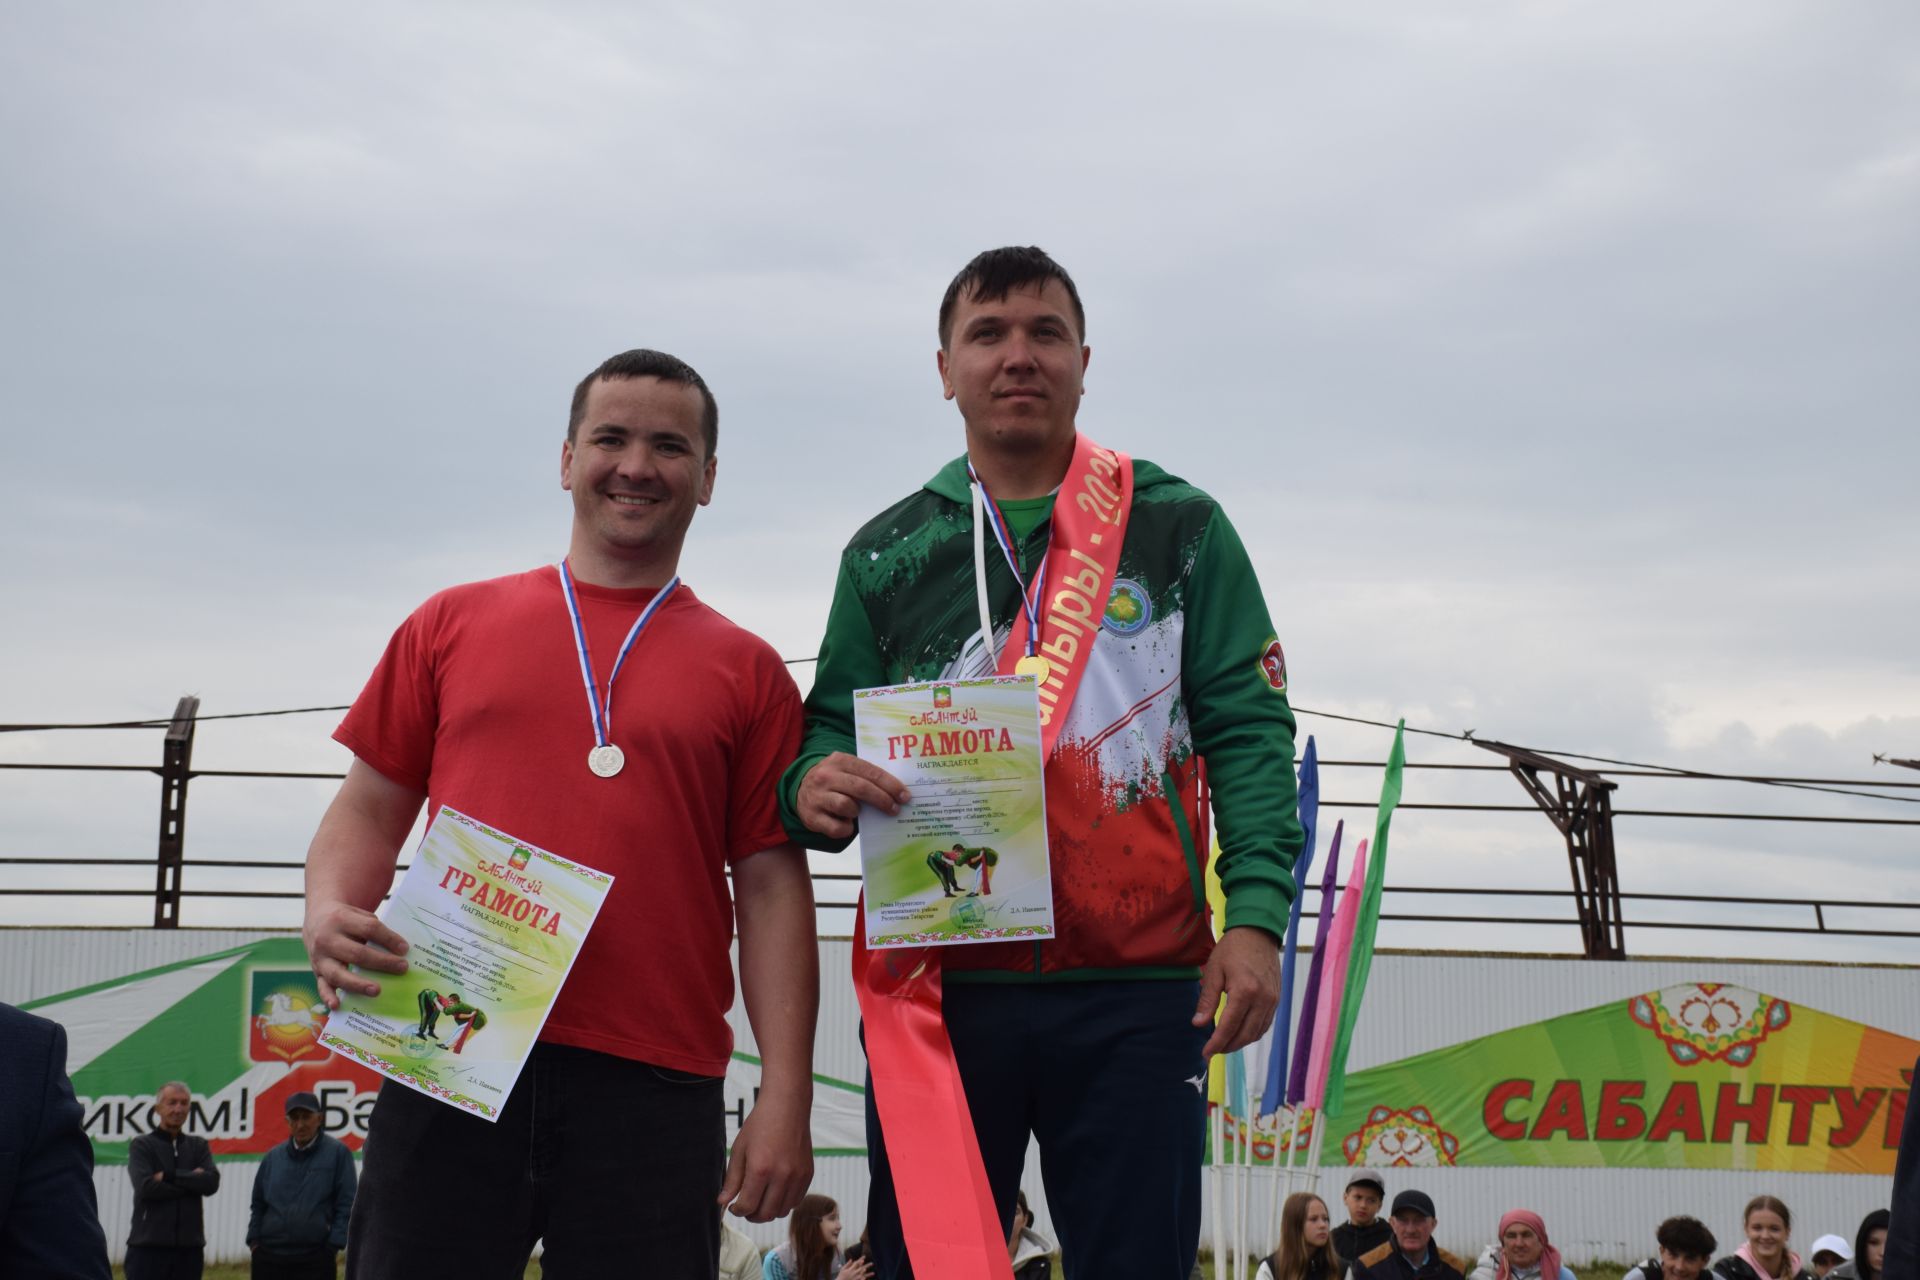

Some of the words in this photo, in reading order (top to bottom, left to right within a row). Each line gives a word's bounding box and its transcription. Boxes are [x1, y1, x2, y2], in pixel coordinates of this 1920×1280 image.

[888, 727, 1015, 760] ГРАМОТА
[917, 758, 978, 769] НАГРАЖДАЕТСЯ
[439, 866, 561, 936] ГРАМОТА
[461, 904, 520, 934] НАГРАЖДАЕТСЯ
